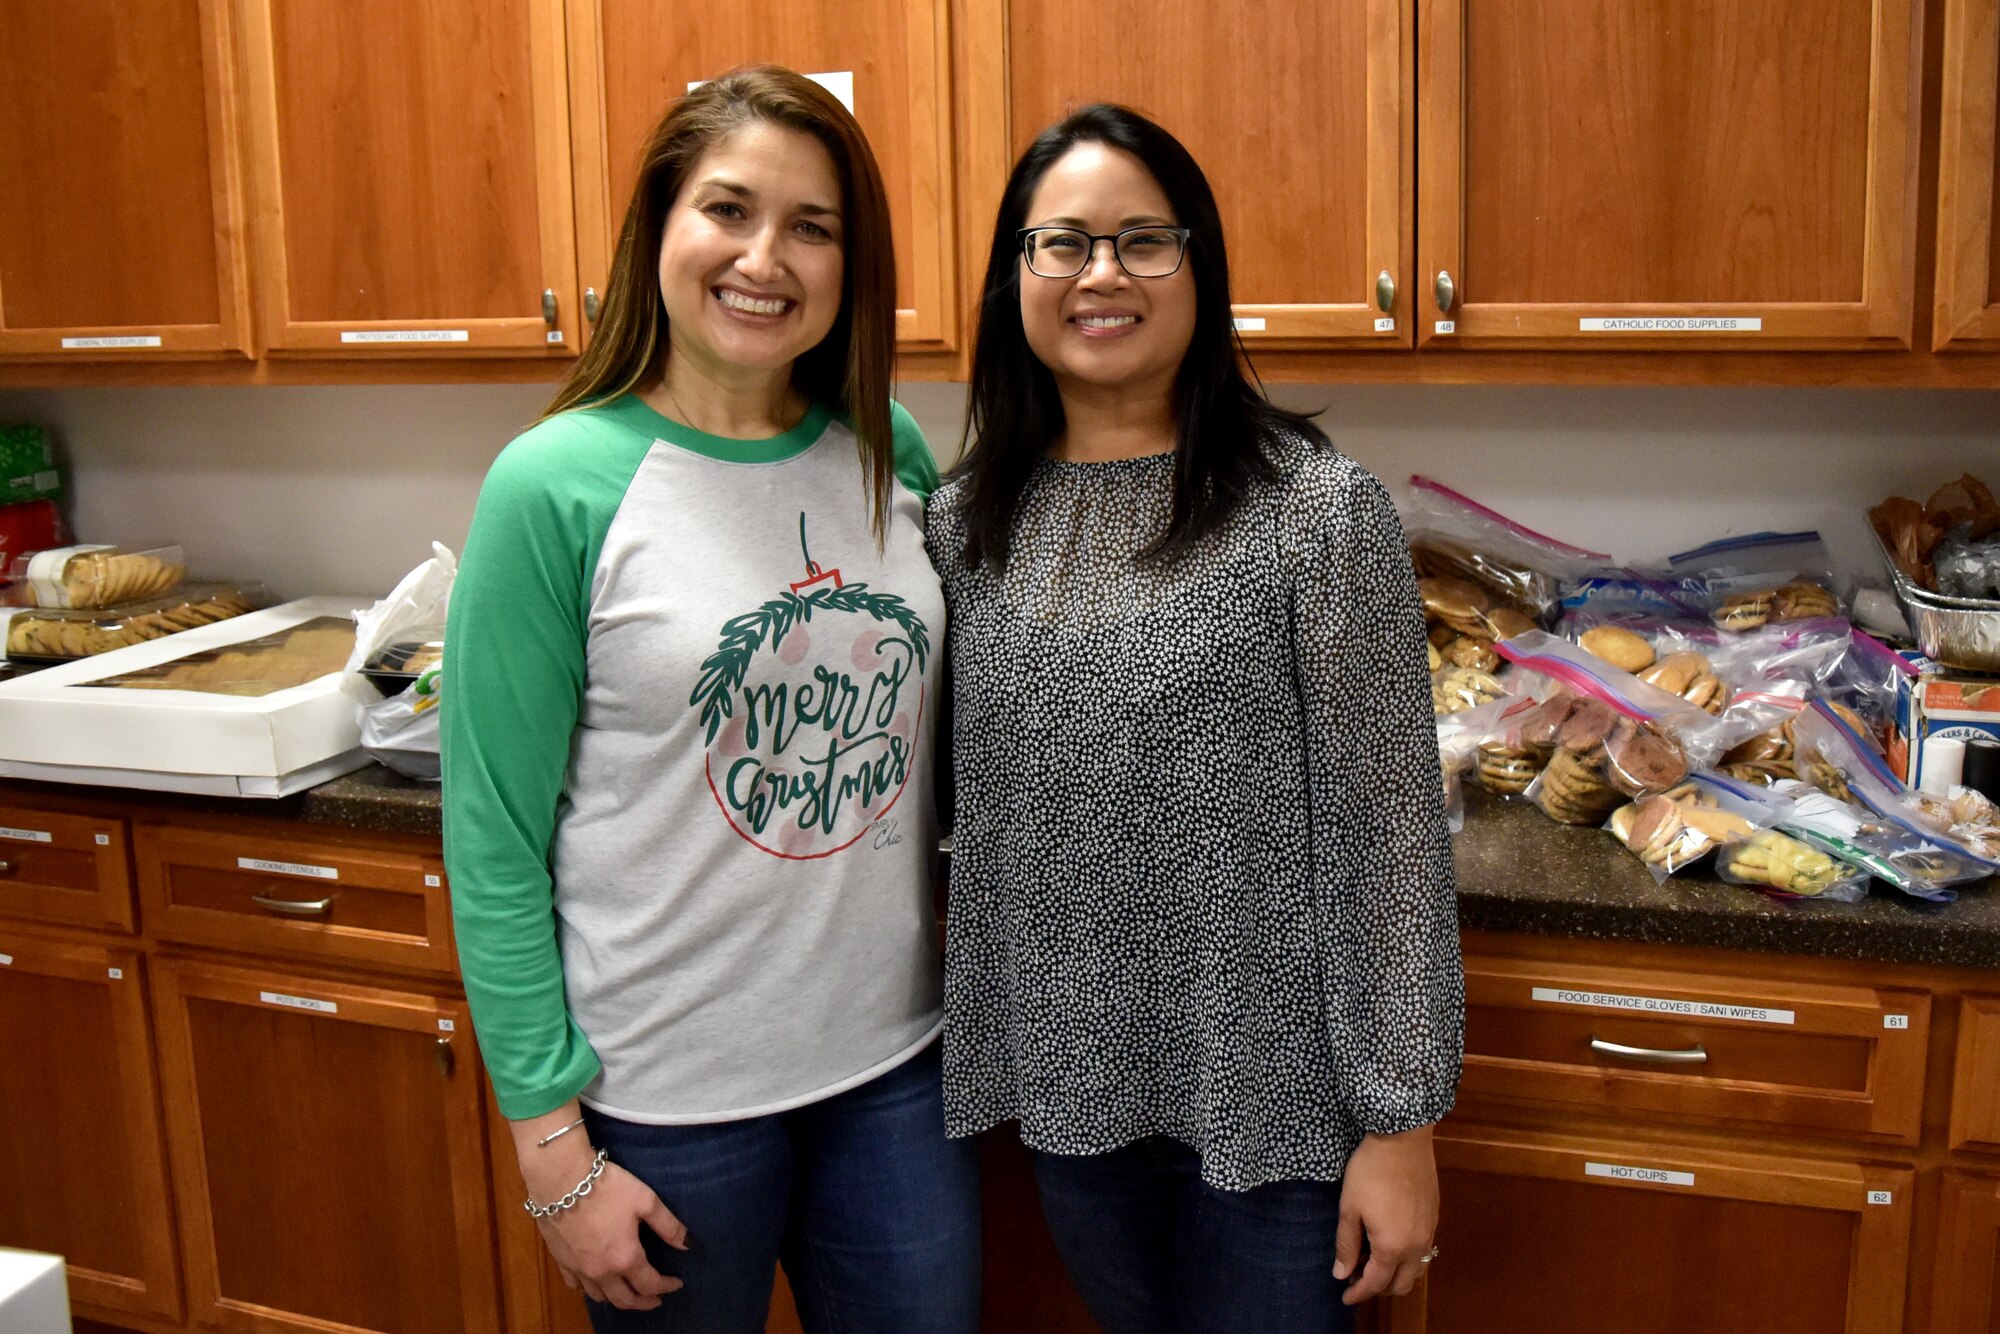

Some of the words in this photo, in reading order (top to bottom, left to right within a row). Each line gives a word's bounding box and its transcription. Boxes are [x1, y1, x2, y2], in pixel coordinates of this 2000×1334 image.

[1379, 320, 1390, 329] 47
[1440, 323, 1452, 331] 48
[1603, 319, 1654, 329] CATHOLIC
[1656, 319, 1685, 329] FOOD
[1687, 319, 1737, 329] SUPPLIES
[1963, 728, 1970, 737] &
[873, 821, 903, 850] Chic
[1557, 991, 1590, 1003] FOOD
[1592, 994, 1642, 1008] SERVICE
[1644, 999, 1691, 1013] GLOVES
[1699, 1004, 1728, 1016] SANI
[1730, 1006, 1767, 1020] WIPES
[1889, 1016, 1903, 1027] 61
[1610, 1166, 1634, 1178] HOT
[1636, 1169, 1668, 1182] CUPS
[1873, 1193, 1887, 1203] 62
